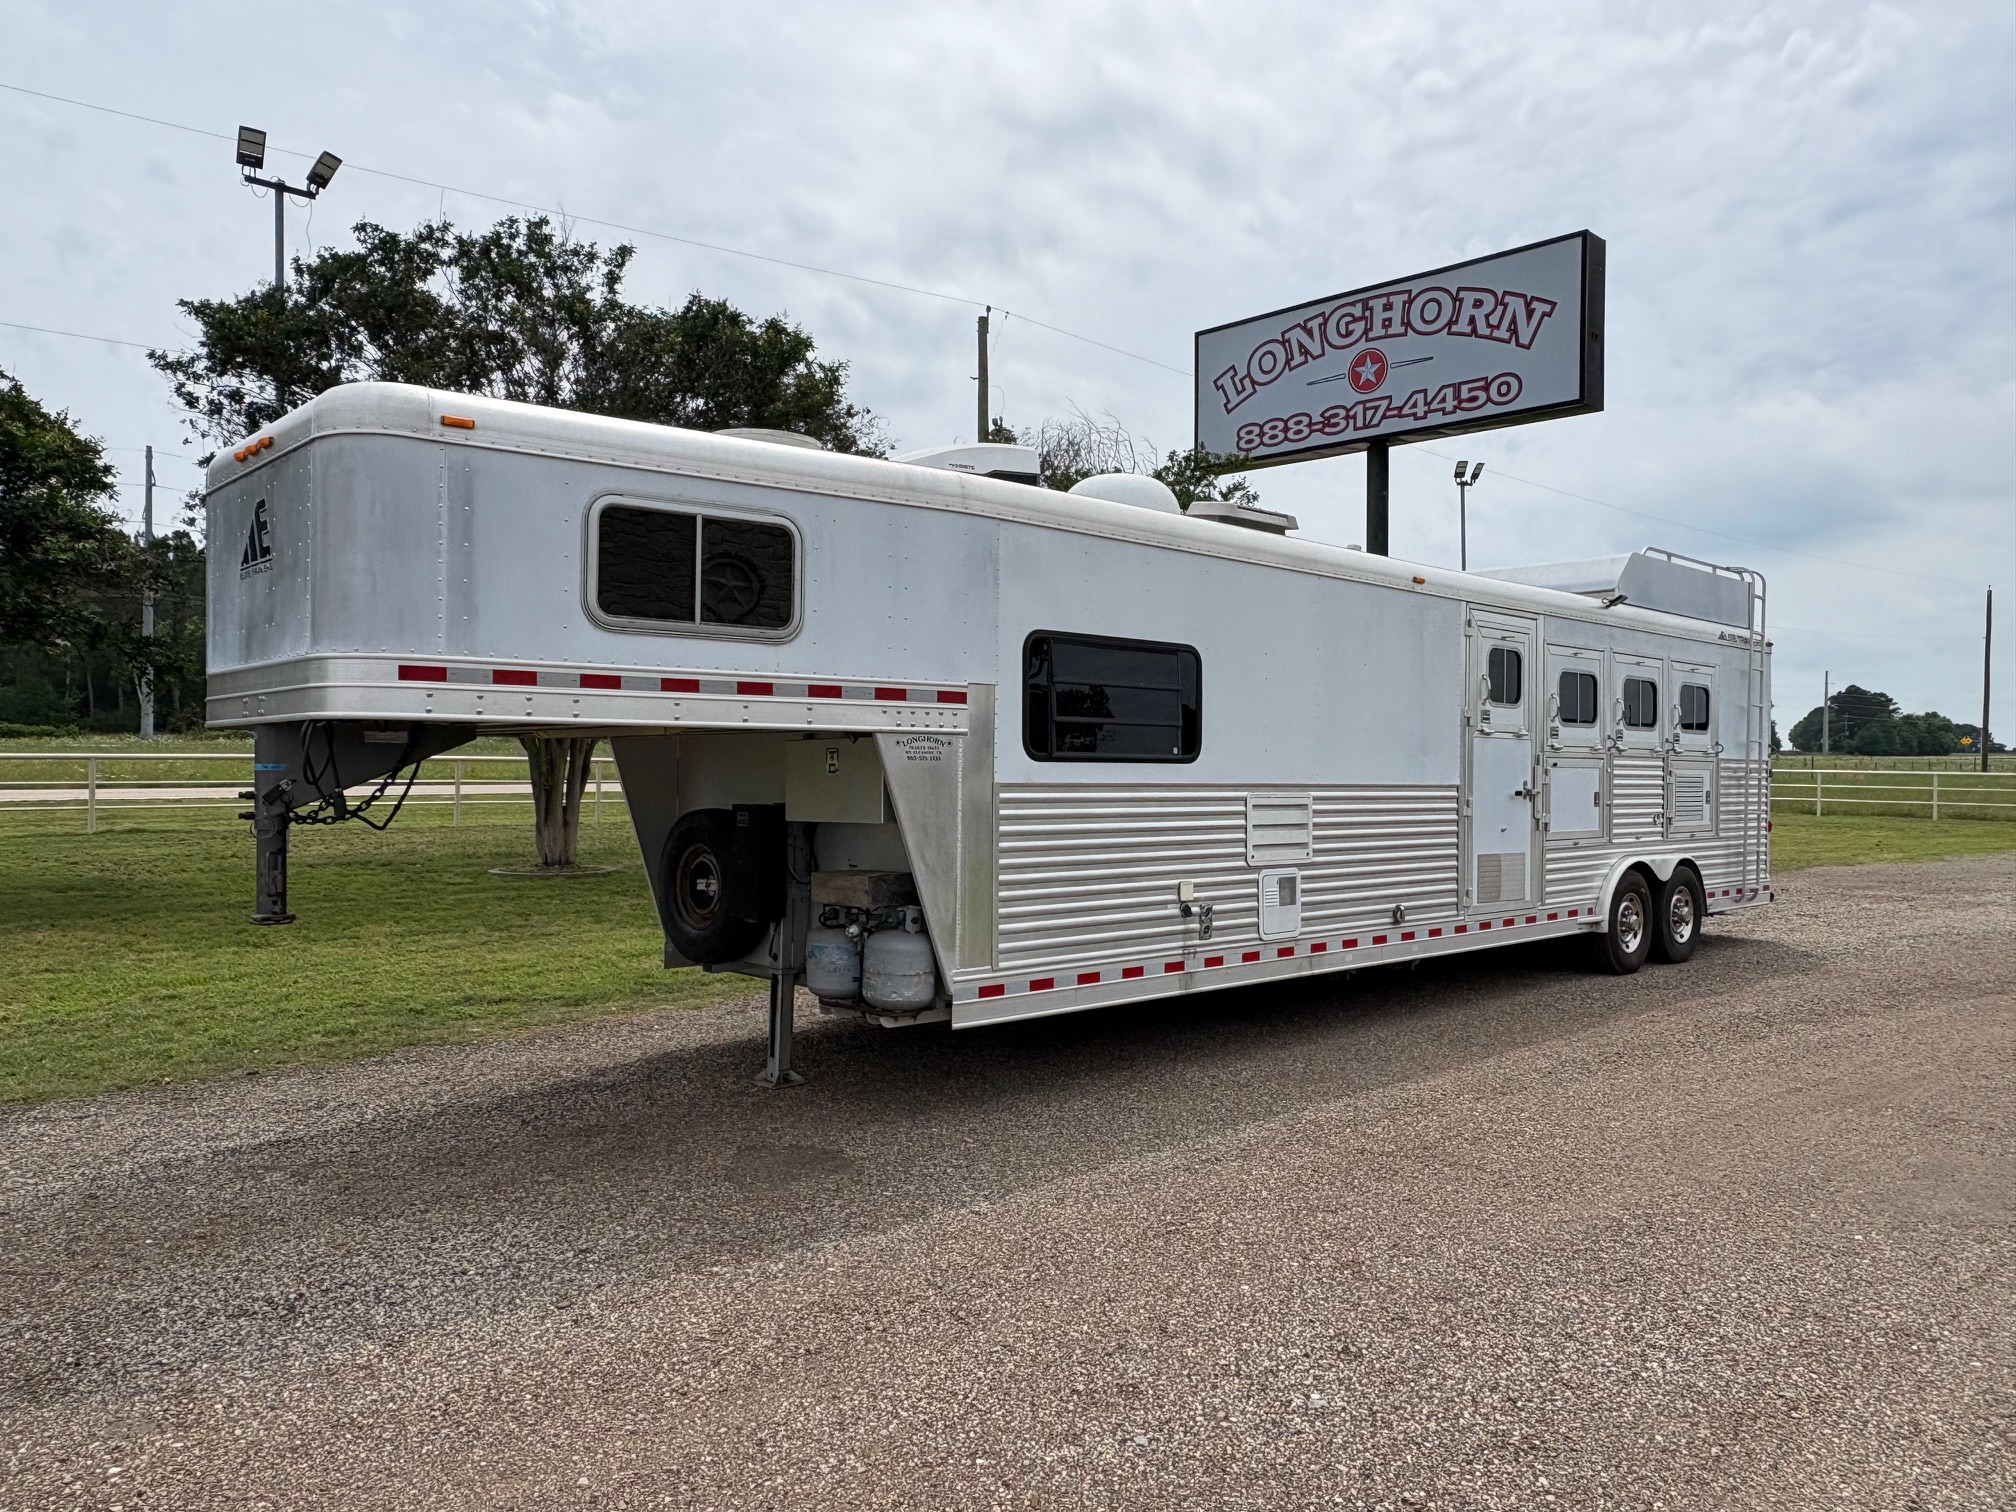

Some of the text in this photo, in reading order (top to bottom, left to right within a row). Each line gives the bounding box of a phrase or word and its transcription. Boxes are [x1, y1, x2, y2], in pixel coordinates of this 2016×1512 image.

[1213, 286, 1557, 415] LONGHORN
[1236, 372, 1523, 453] 888-317-4450
[902, 735, 946, 747] LONGHORN
